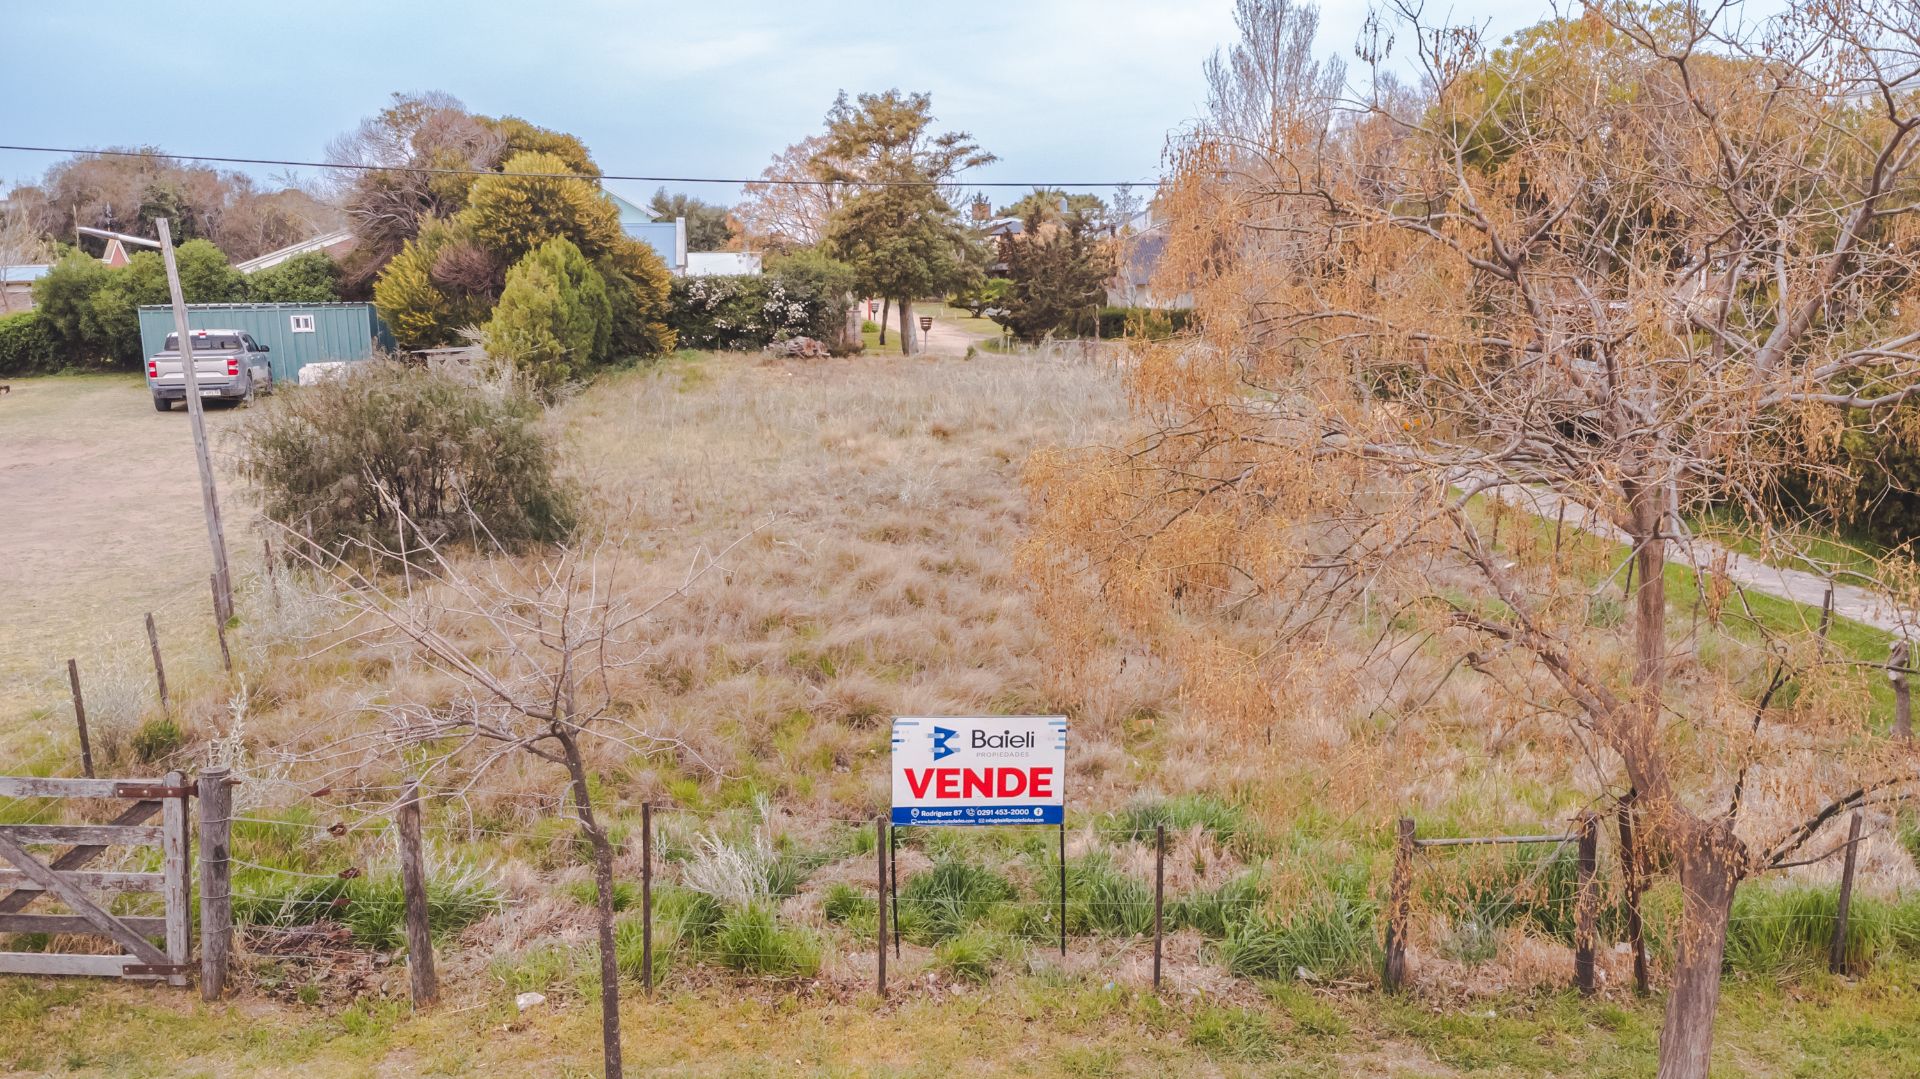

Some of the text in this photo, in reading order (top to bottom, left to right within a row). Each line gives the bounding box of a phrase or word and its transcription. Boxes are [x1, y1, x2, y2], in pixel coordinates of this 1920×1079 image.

[971, 730, 1035, 748] Baieli
[904, 767, 1053, 798] VENDE
[994, 808, 1030, 816] 453-2000
